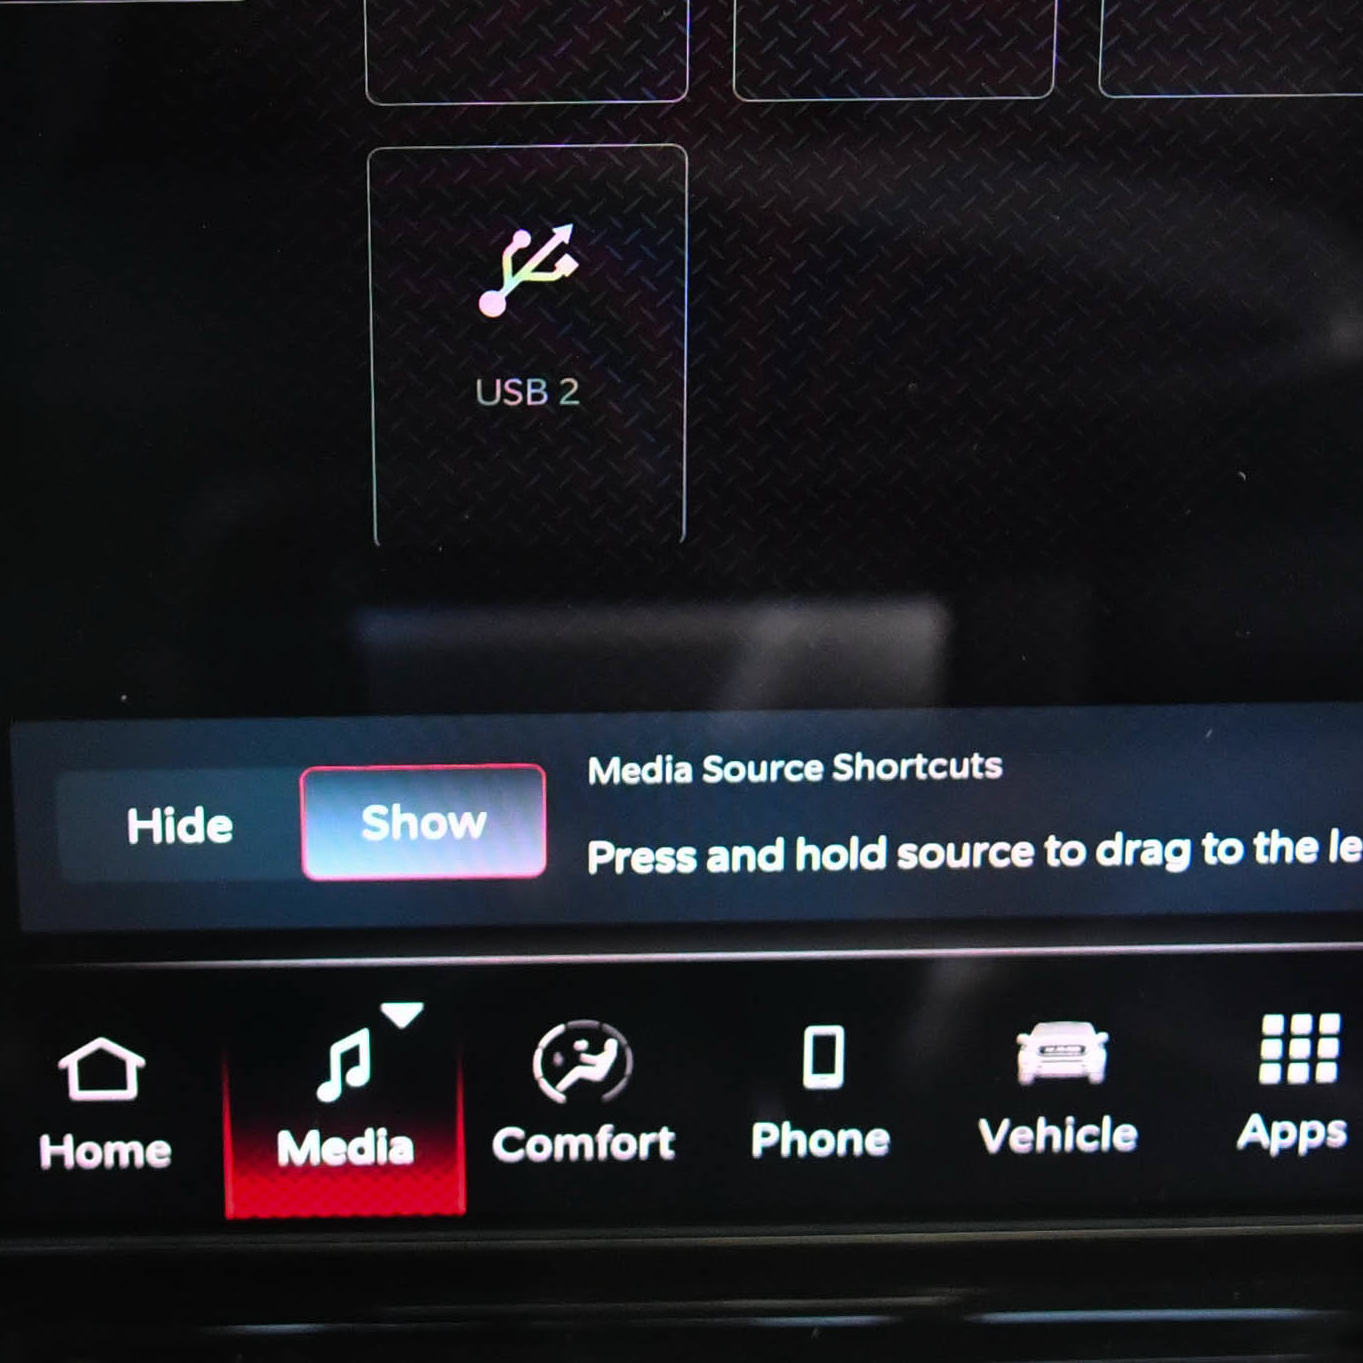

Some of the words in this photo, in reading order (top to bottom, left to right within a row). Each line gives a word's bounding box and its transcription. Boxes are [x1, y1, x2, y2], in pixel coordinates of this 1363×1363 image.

[476, 378, 548, 406] USB
[559, 377, 580, 405] 2
[588, 754, 693, 785] Media
[702, 754, 824, 784] Source
[832, 751, 1003, 782] Shortcuts
[127, 805, 233, 845] Hide
[360, 803, 488, 840] Show
[588, 840, 697, 875] Press
[706, 836, 785, 873] and
[796, 834, 887, 872] hold
[897, 841, 1035, 870] source
[1043, 834, 1087, 868] to
[1095, 831, 1191, 874] drag
[1201, 831, 1244, 866] to
[1252, 828, 1319, 865] the
[39, 1133, 172, 1170] Home
[277, 1126, 415, 1167] Media
[492, 1123, 676, 1163] Comfort
[752, 1120, 891, 1158] Phone
[978, 1114, 1138, 1154] Vehicle
[1236, 1113, 1347, 1157] Apps
